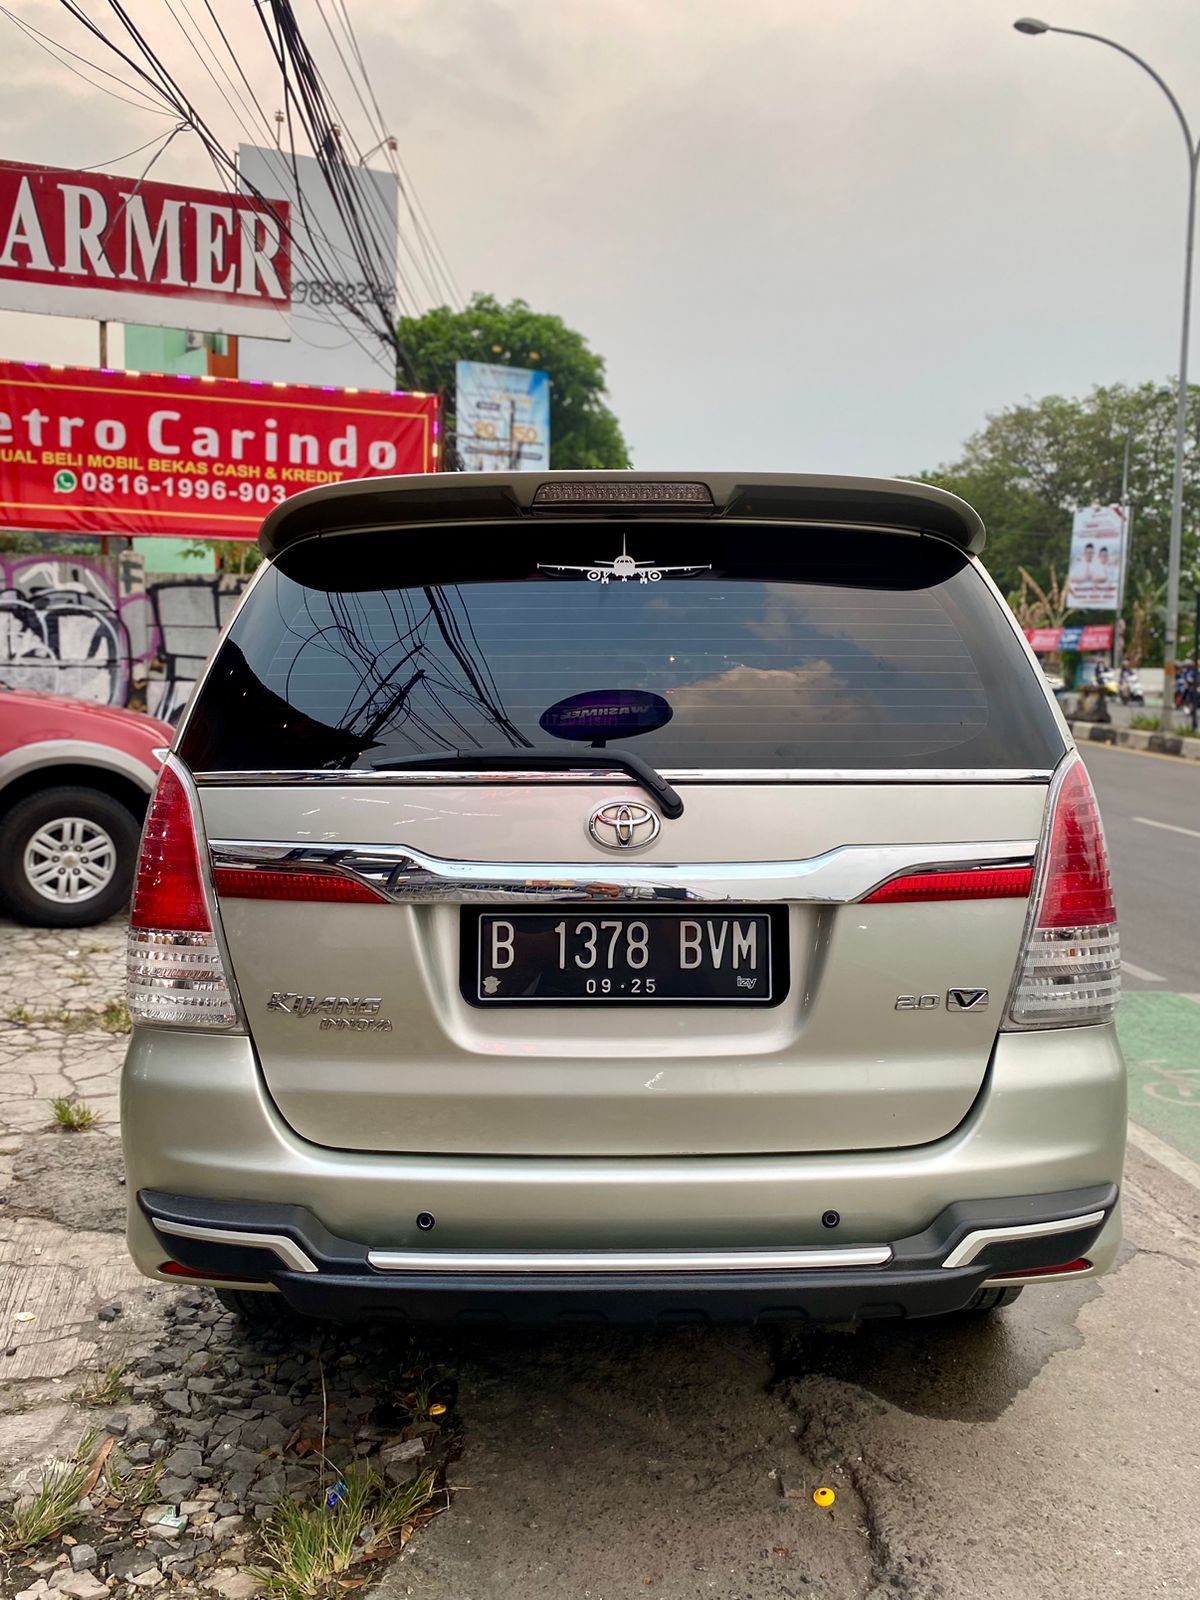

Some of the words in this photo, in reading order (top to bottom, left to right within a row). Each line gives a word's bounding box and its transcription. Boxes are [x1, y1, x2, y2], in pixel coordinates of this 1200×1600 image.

[0, 176, 288, 299] ARMER
[147, 410, 397, 470] Carindo
[42, 451, 83, 467] BELI
[87, 454, 144, 471] MOBIL
[148, 458, 208, 475] BEKAS
[212, 462, 260, 479] CASH
[264, 466, 277, 480] &
[281, 467, 343, 483] KREDIT
[81, 471, 287, 504] 0816-1996-903
[491, 920, 515, 969] B
[554, 920, 650, 970] 1378
[679, 920, 757, 970] BVM
[894, 993, 941, 1011] 2.0
[951, 989, 988, 1010] V
[319, 1017, 393, 1032] INNOVA
